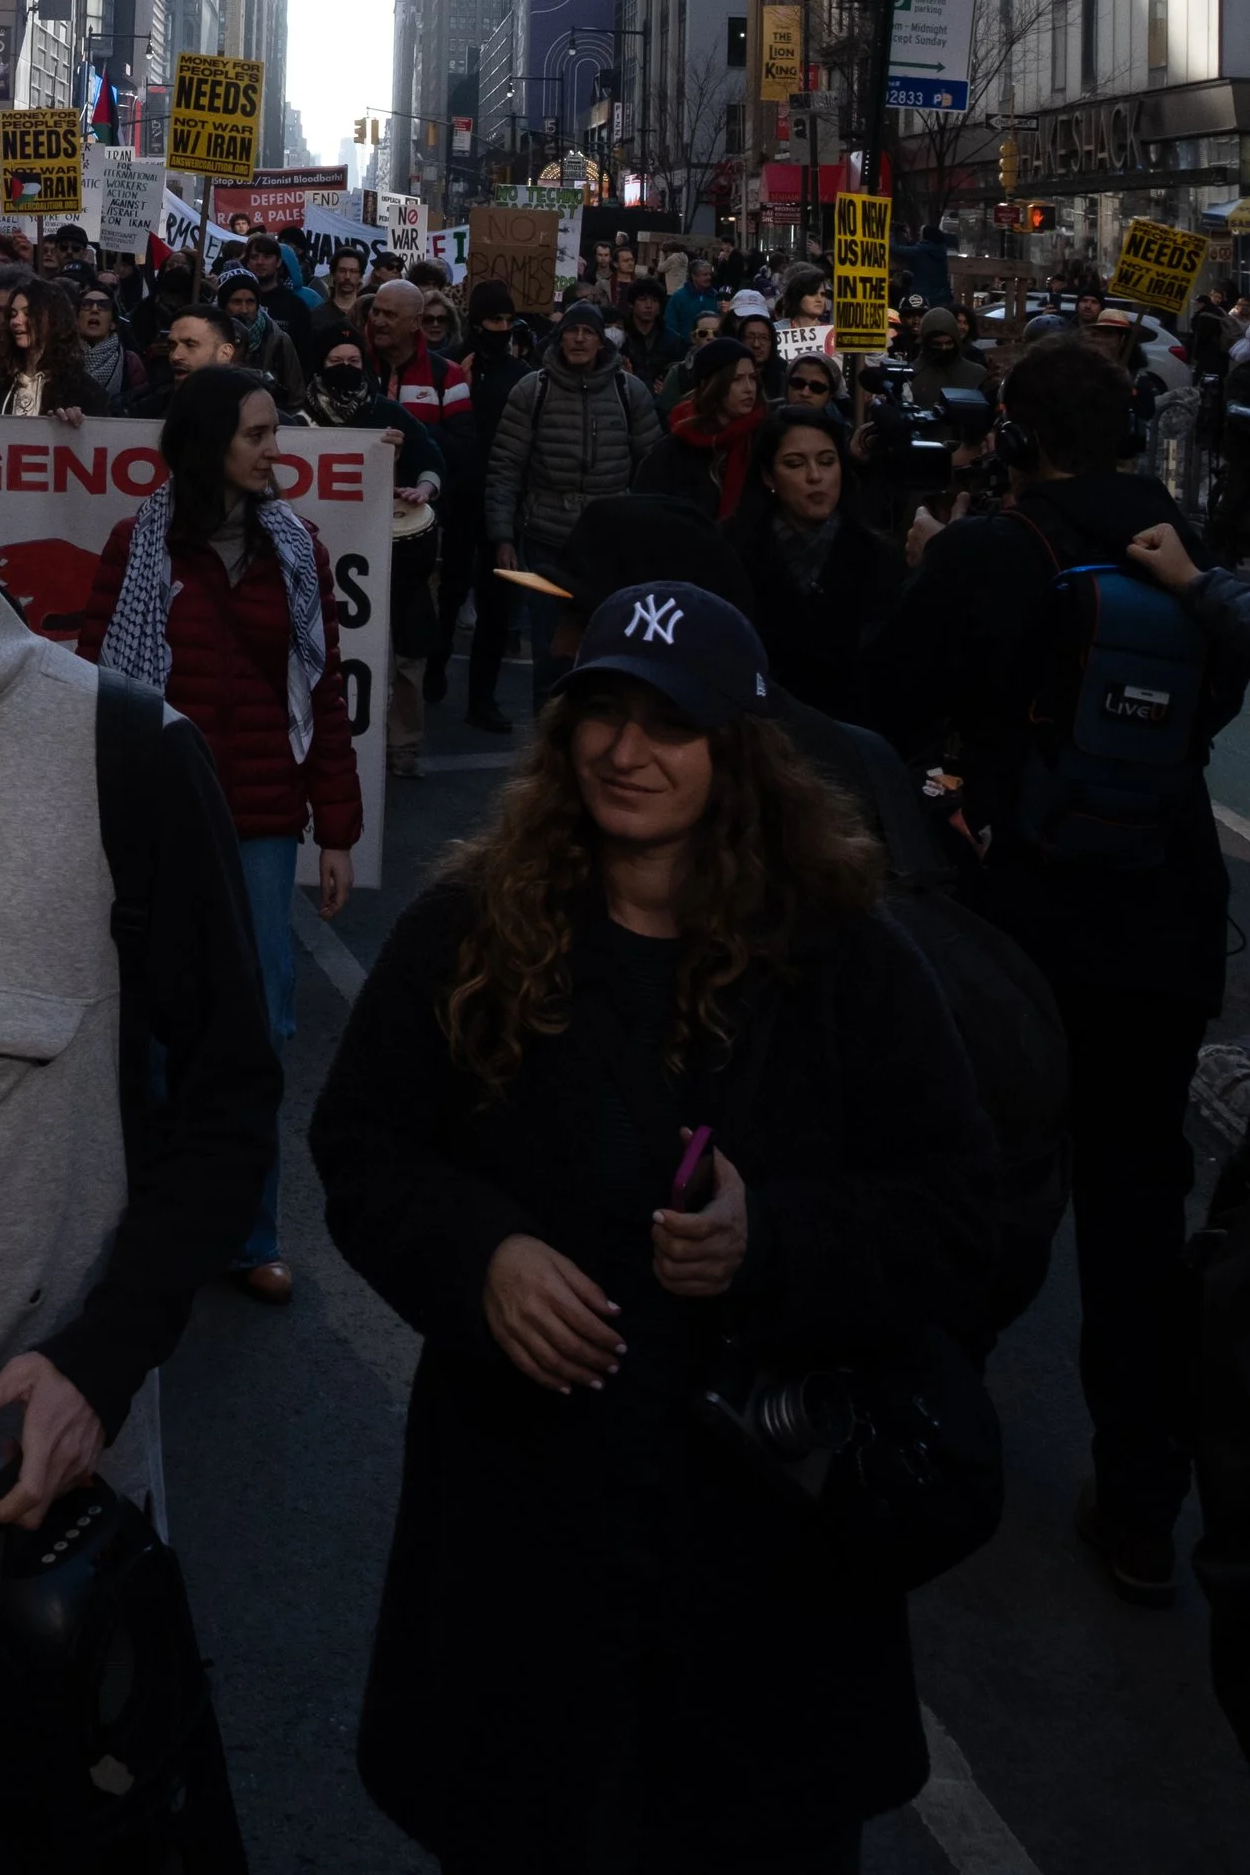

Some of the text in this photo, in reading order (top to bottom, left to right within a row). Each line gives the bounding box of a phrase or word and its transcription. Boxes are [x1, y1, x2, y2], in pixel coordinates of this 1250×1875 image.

[913, 5, 943, 16] parking
[772, 31, 792, 42] THE
[910, 23, 948, 36] Midnight
[915, 34, 947, 47] Sunday
[180, 55, 260, 73] MONEY FOR
[179, 65, 260, 83] PEOPLE'S
[175, 76, 258, 117] NEEDS
[886, 89, 924, 107] 2833
[2, 112, 77, 120] MONEY FOR
[2, 119, 77, 129] PEOPLE'S
[174, 117, 209, 130] NOT
[211, 122, 253, 135] WAR
[3, 129, 78, 160] NEEDS
[172, 129, 201, 155] W/
[206, 133, 251, 162] IRAN
[1018, 99, 1144, 177] HAKE SHACK
[40, 166, 77, 174] WAR
[117, 162, 132, 171] FOR
[170, 155, 250, 176] ANSWERCOALITION.ORG
[106, 179, 148, 192] WORKERS
[213, 173, 343, 188] Stop Bloodbath!
[107, 189, 138, 199] ACTION
[251, 191, 304, 207] DEFEND
[312, 192, 340, 206] END
[496, 185, 584, 205] NO TECHNO
[111, 198, 148, 211] AGAINST
[65, 214, 80, 222] ON
[838, 198, 857, 237] NO
[862, 200, 888, 240] NEW
[488, 214, 537, 242] NO
[1135, 221, 1207, 246] MONEY FOR
[306, 229, 388, 267] HANDS
[391, 229, 419, 251] WAR
[838, 239, 887, 268] US WAR
[1125, 233, 1202, 273] NEEDS
[1121, 260, 1191, 285] NOT WAR
[837, 276, 887, 299] IN THE
[1149, 276, 1189, 301] IRAN
[836, 301, 886, 330] MIDDLE EAST
[623, 593, 684, 646] NY
